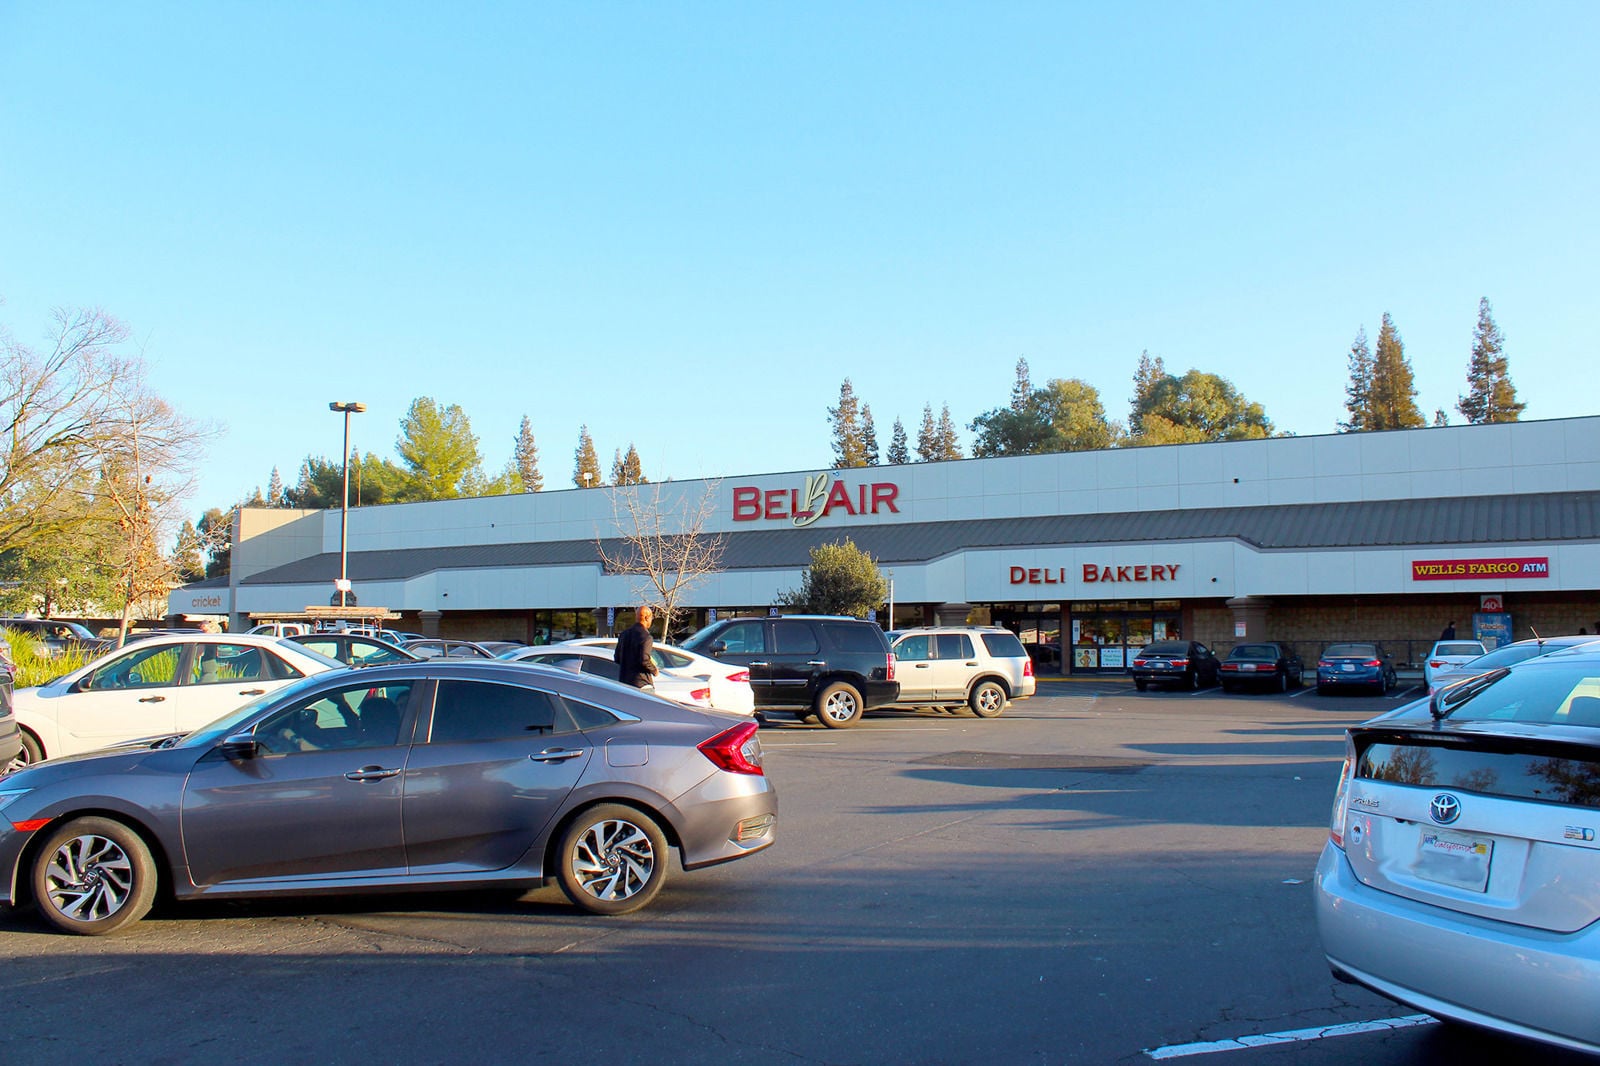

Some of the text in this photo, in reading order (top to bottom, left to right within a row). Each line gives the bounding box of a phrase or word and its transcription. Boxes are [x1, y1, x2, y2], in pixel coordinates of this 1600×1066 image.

[1009, 563, 1181, 585] DELI BAKERY
[1414, 562, 1546, 575] WELLS FARGO ATM
[191, 595, 221, 608] cricket
